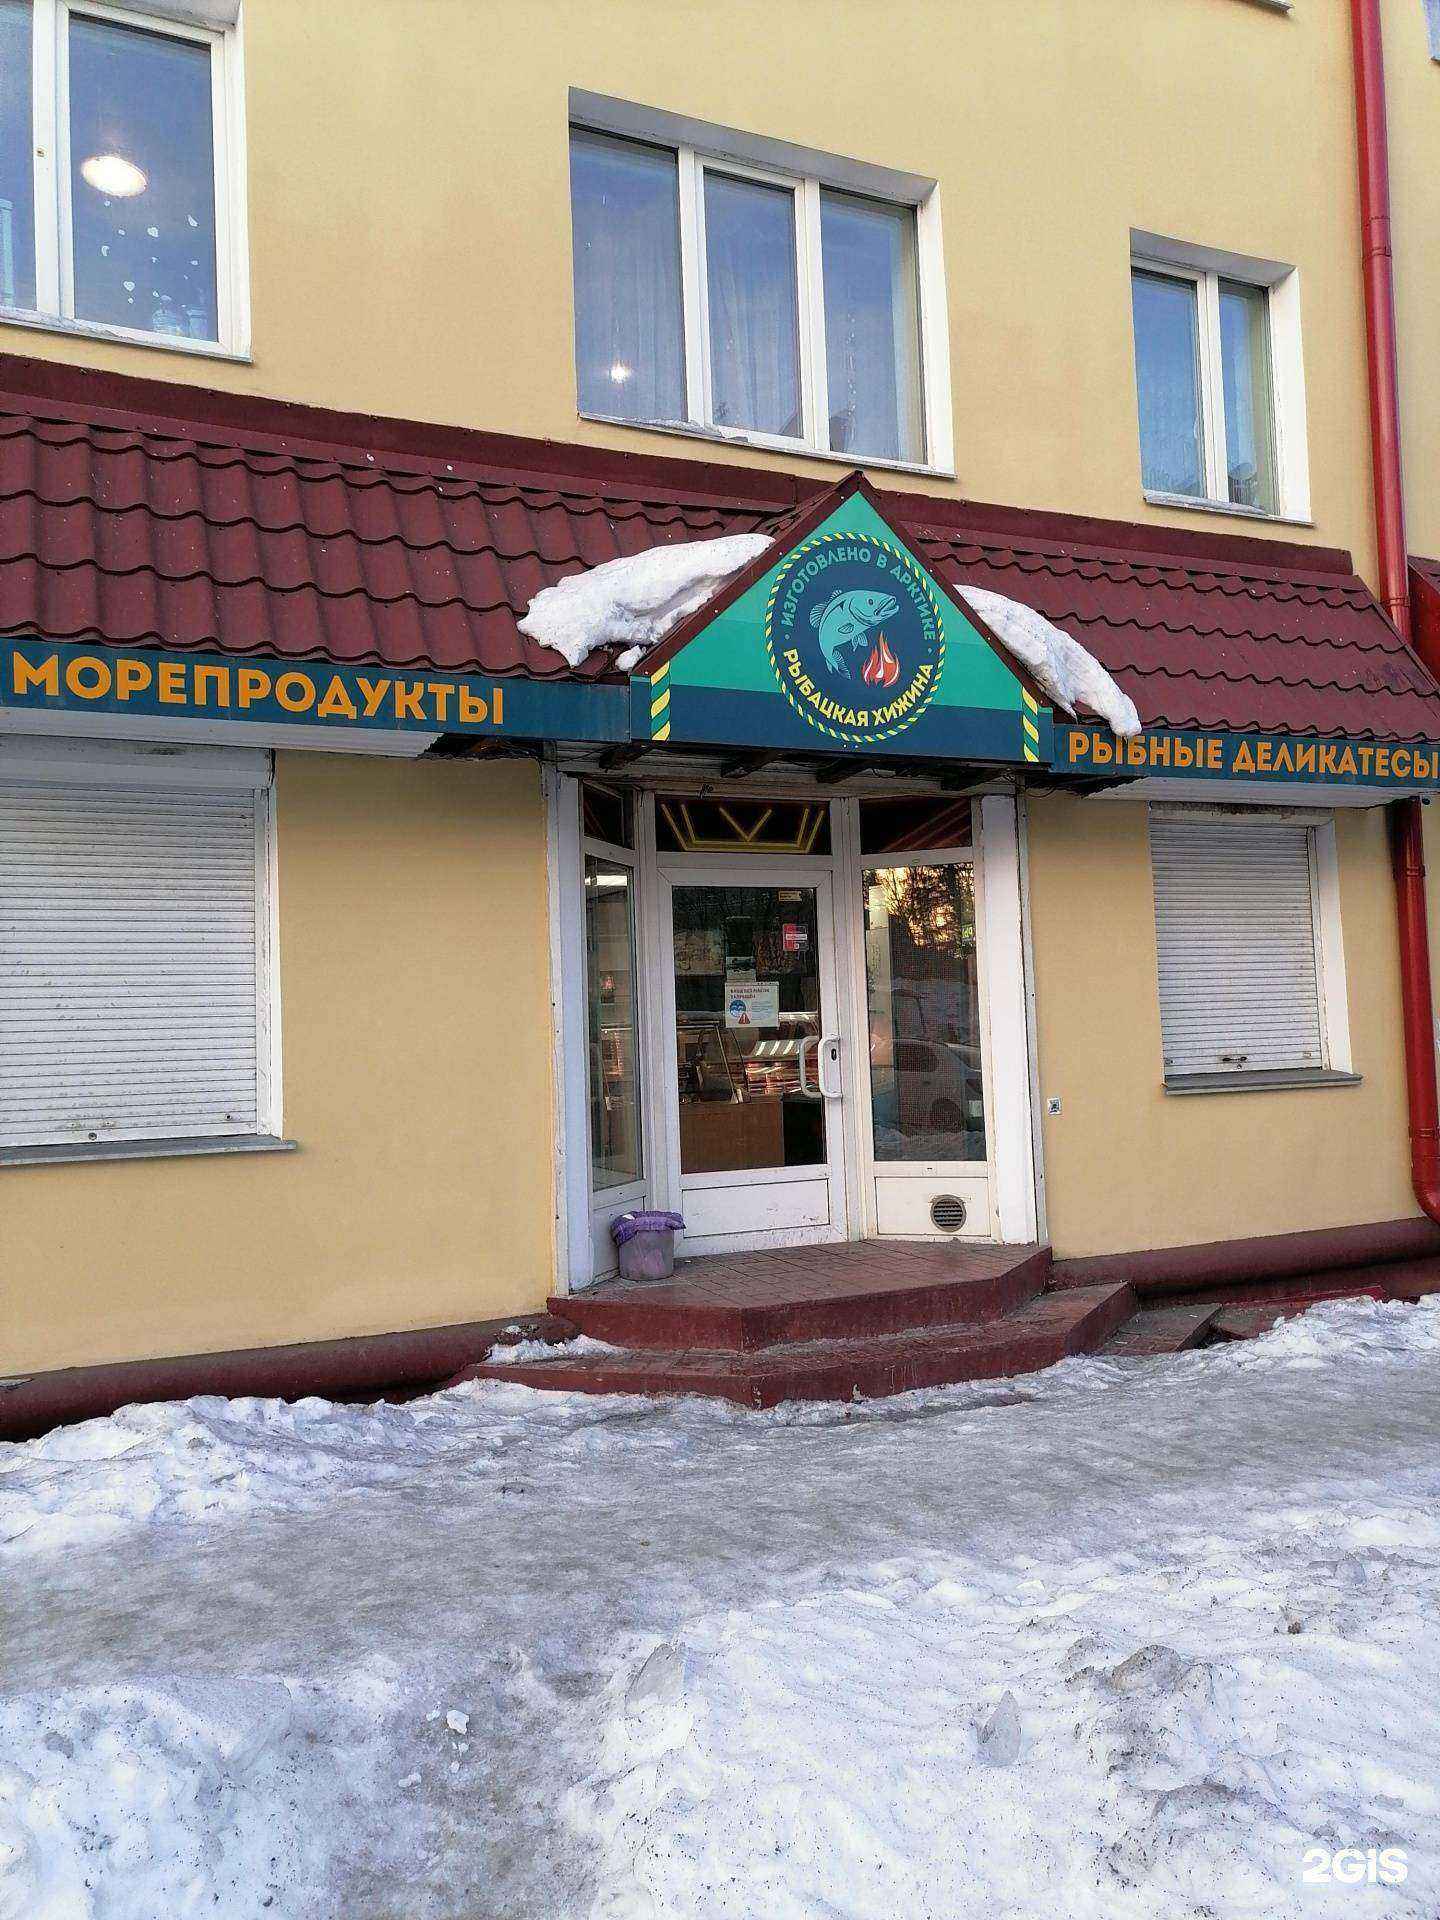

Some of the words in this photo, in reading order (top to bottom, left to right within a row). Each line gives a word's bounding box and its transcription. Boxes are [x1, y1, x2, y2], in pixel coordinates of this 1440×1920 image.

[781, 546, 871, 627] ИЗГОТОВЛЕНО
[876, 553, 888, 569] В
[890, 565, 936, 641] АРКТИКЕ
[12, 651, 504, 725] МОРЕПРОДУКТЫ
[784, 648, 869, 727] РЫБАЦКАЯ
[872, 664, 934, 727] ХИЖИНА
[1068, 731, 1223, 769] РЫБНЫЕ
[1232, 740, 1439, 779] ДЕЛИКАТЕСЫ
